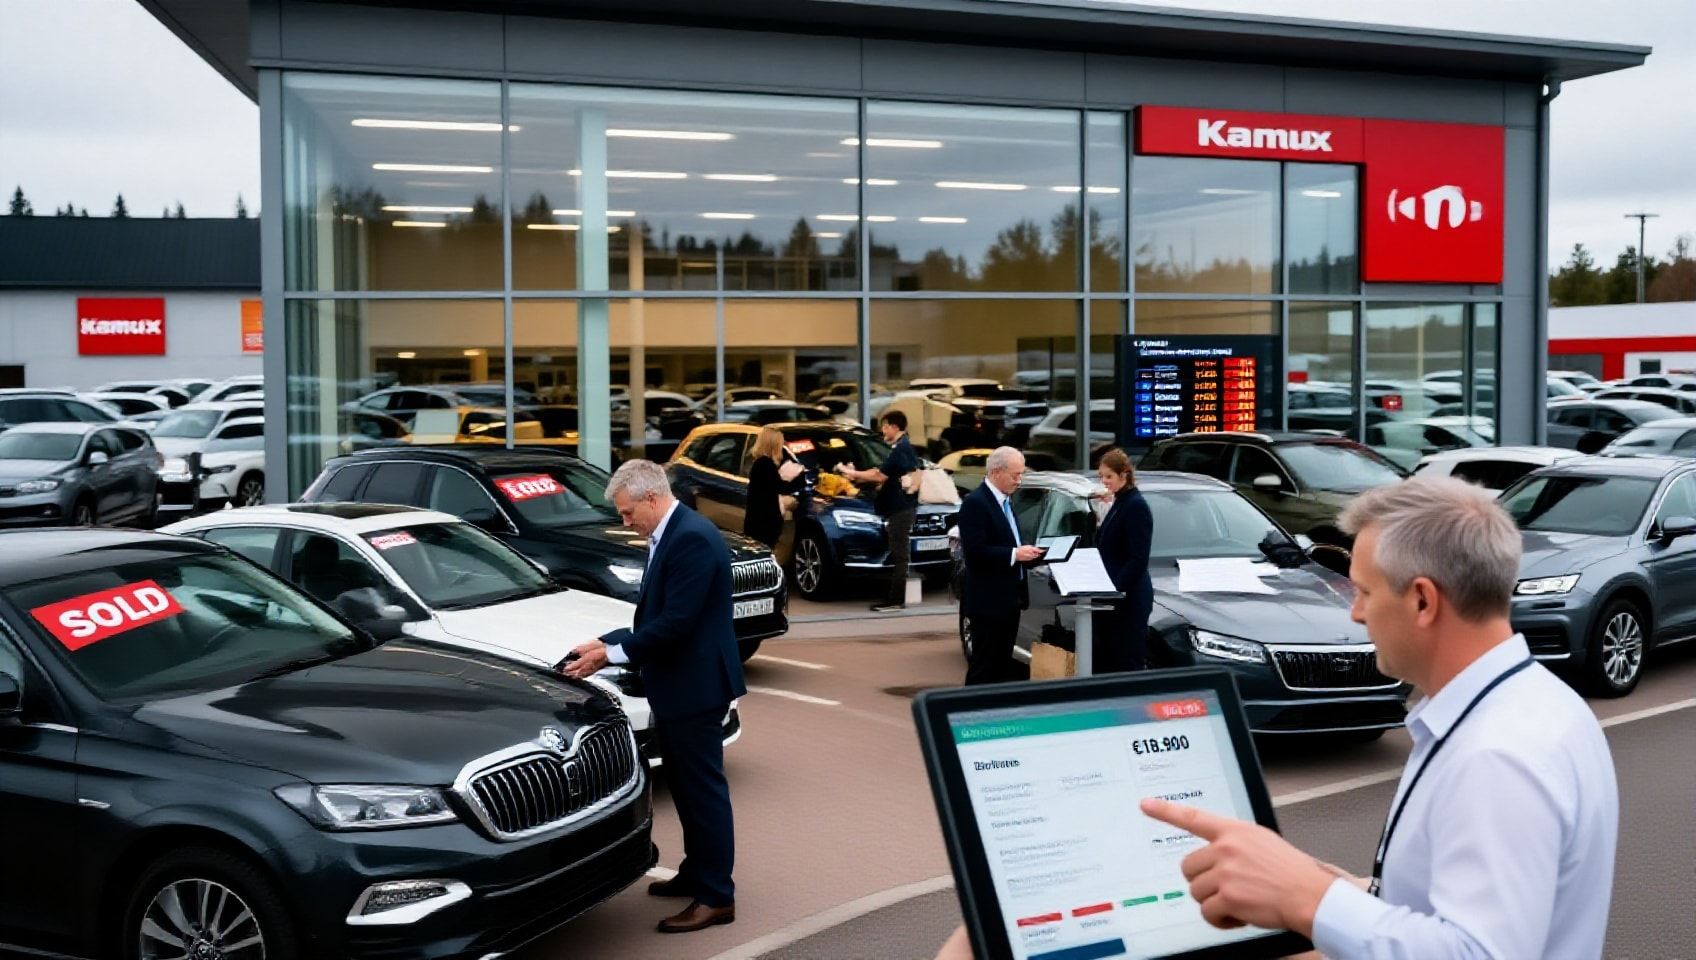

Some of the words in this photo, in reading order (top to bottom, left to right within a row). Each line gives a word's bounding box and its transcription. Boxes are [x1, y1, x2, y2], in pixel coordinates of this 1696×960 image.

[1198, 119, 1333, 152] Kamux
[80, 318, 162, 335] Kamux
[58, 587, 170, 638] SOLD
[1132, 735, 1190, 755] €18.900
